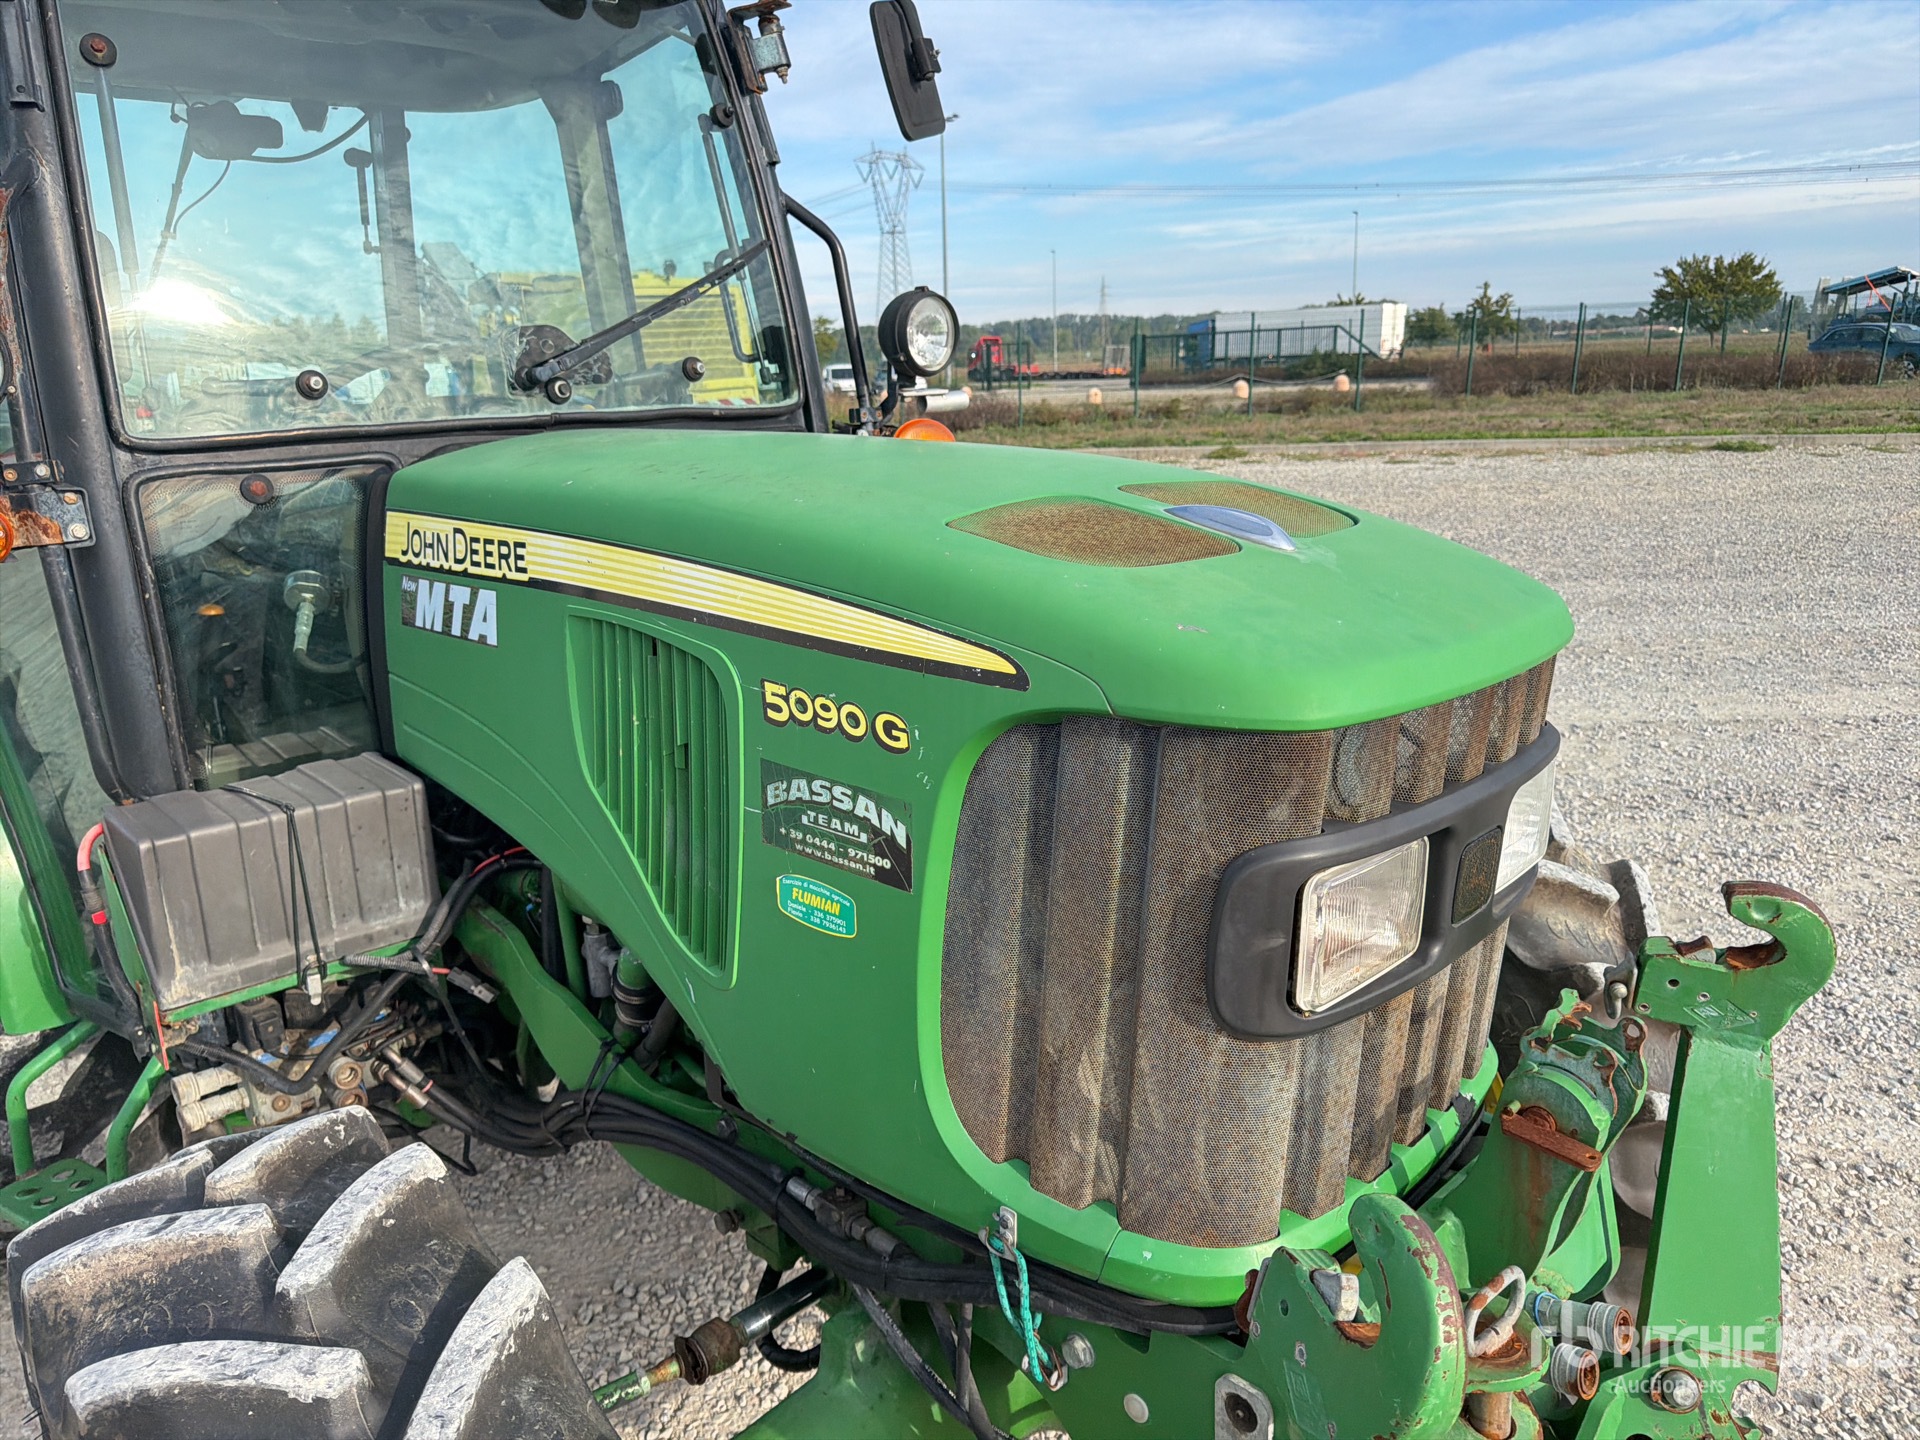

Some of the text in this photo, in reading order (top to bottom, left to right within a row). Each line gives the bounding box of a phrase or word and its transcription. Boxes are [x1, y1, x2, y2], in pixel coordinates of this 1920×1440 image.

[401, 522, 528, 574] JOHN DEERE
[402, 576, 417, 592] New
[415, 579, 498, 646] MTA
[760, 678, 911, 755] 5090 G
[766, 778, 907, 850] BASSAN
[806, 811, 859, 836] TEAM
[789, 829, 803, 840] 39
[806, 833, 836, 851] 0444
[848, 847, 891, 870] 971500
[795, 842, 876, 876] www.bassan.it
[792, 887, 840, 916] FLUMIAN
